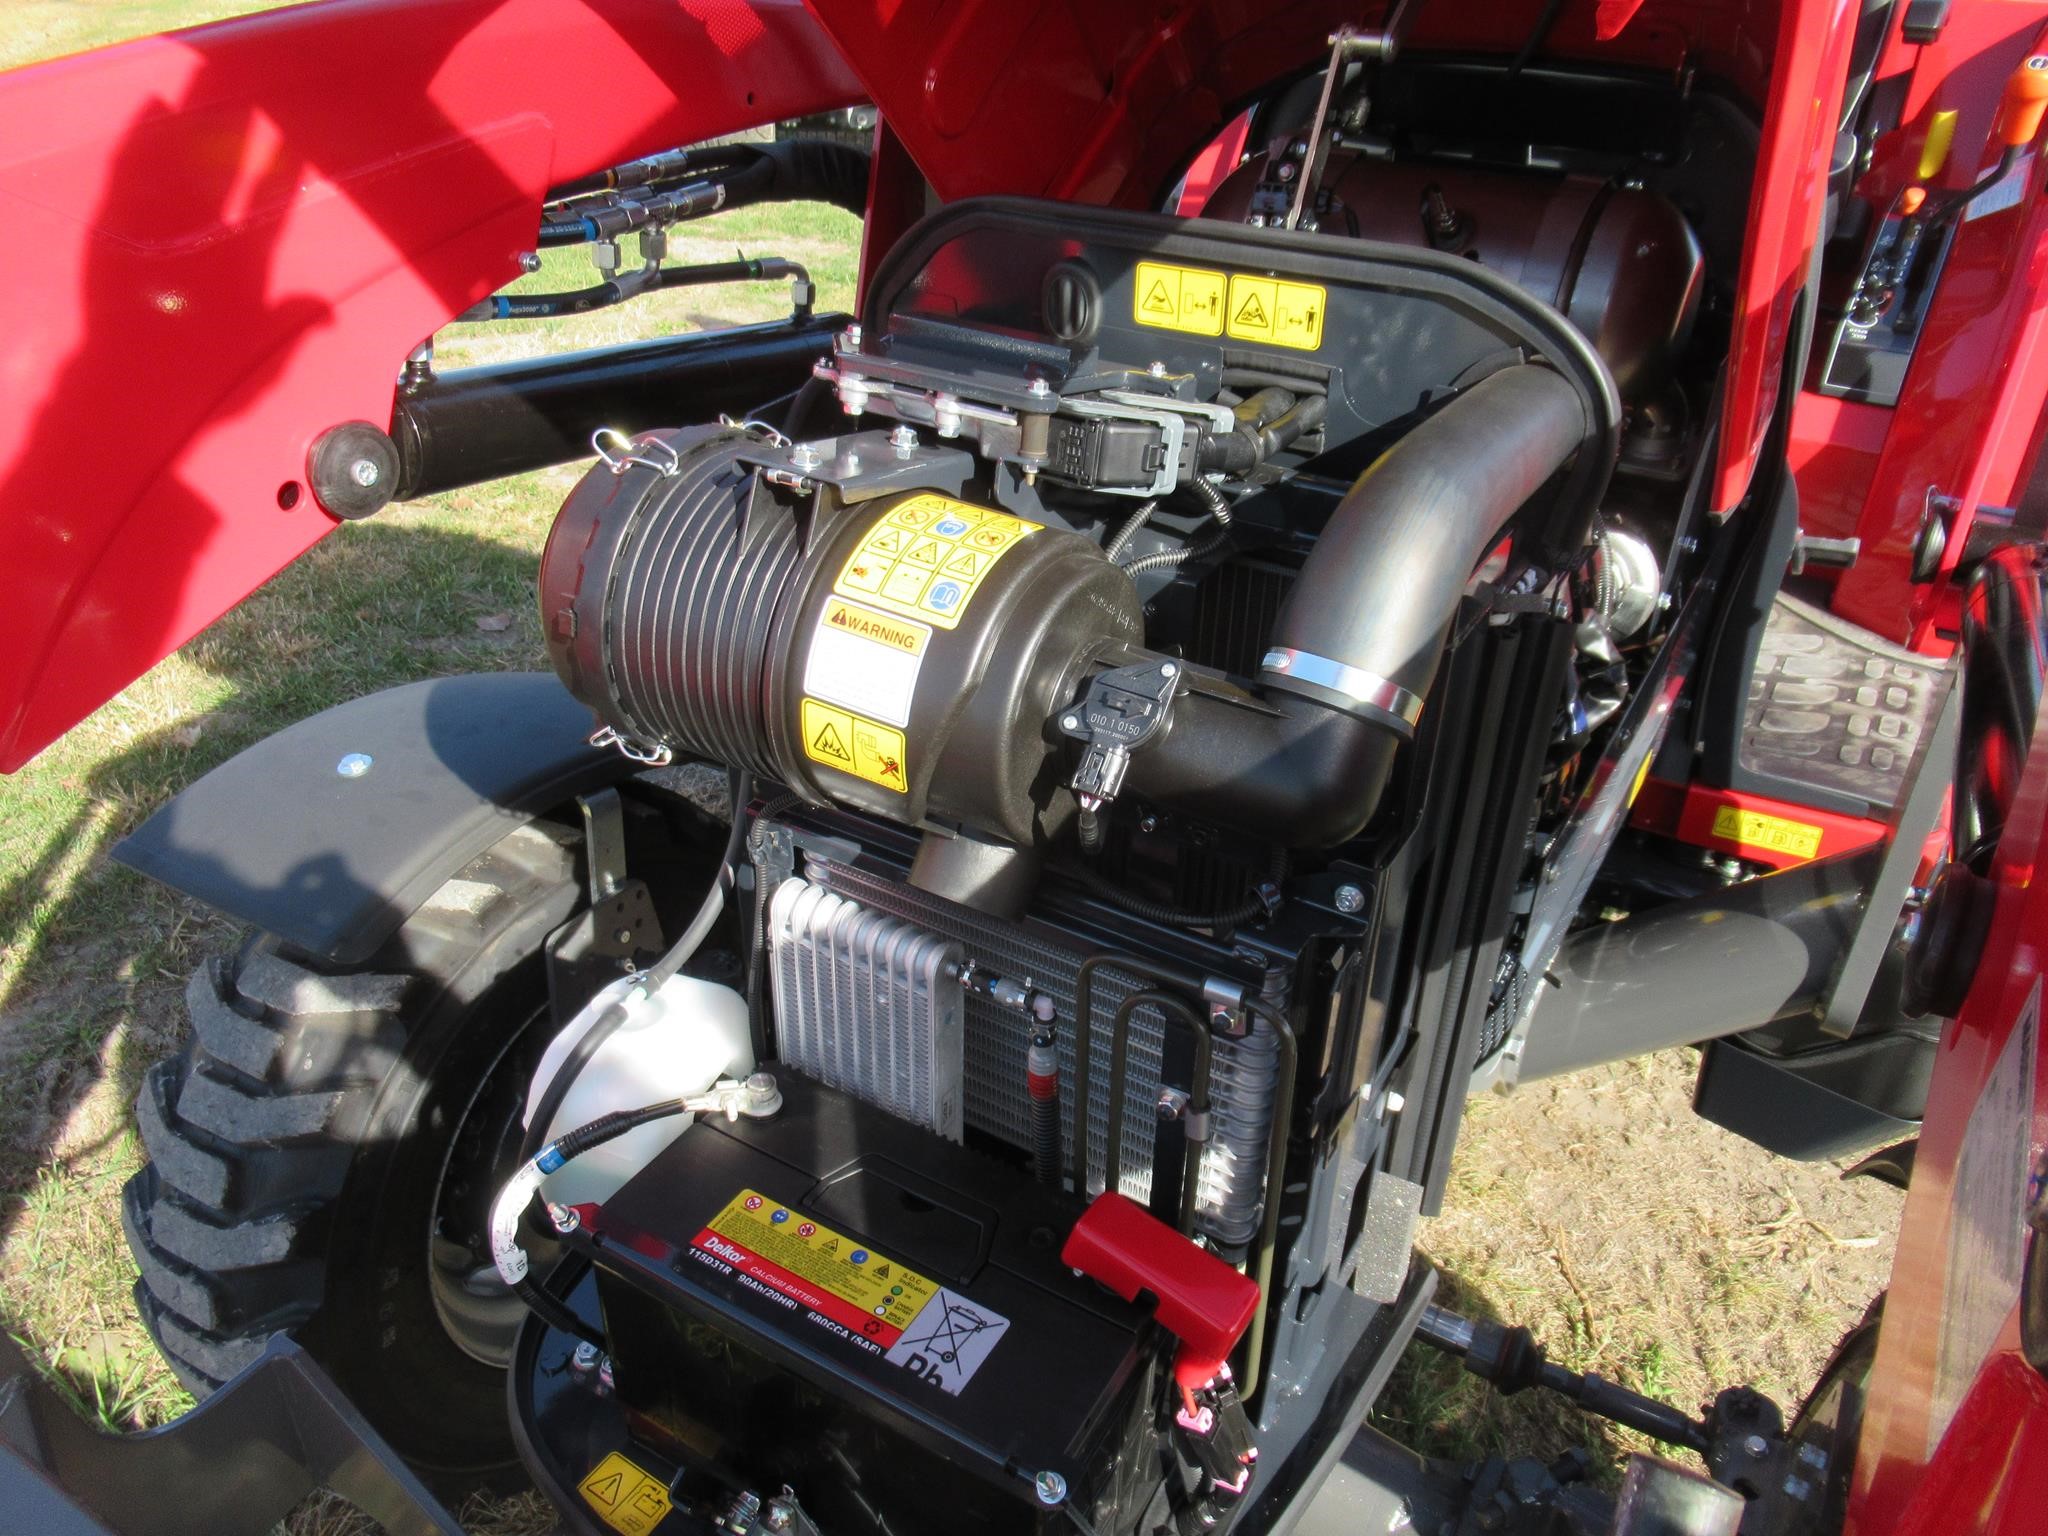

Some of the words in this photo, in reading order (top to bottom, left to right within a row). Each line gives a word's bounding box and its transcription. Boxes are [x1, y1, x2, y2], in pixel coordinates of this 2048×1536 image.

[848, 617, 916, 649] WARNING
[1117, 721, 1140, 736] 0150
[703, 1236, 747, 1264] Delkor
[688, 1247, 733, 1276] 115D31R
[737, 1274, 799, 1311] 90Ah(20HR)
[850, 1334, 882, 1356] (SAE)
[750, 1266, 787, 1292] CALCIUM
[784, 1284, 823, 1307] BATTERY
